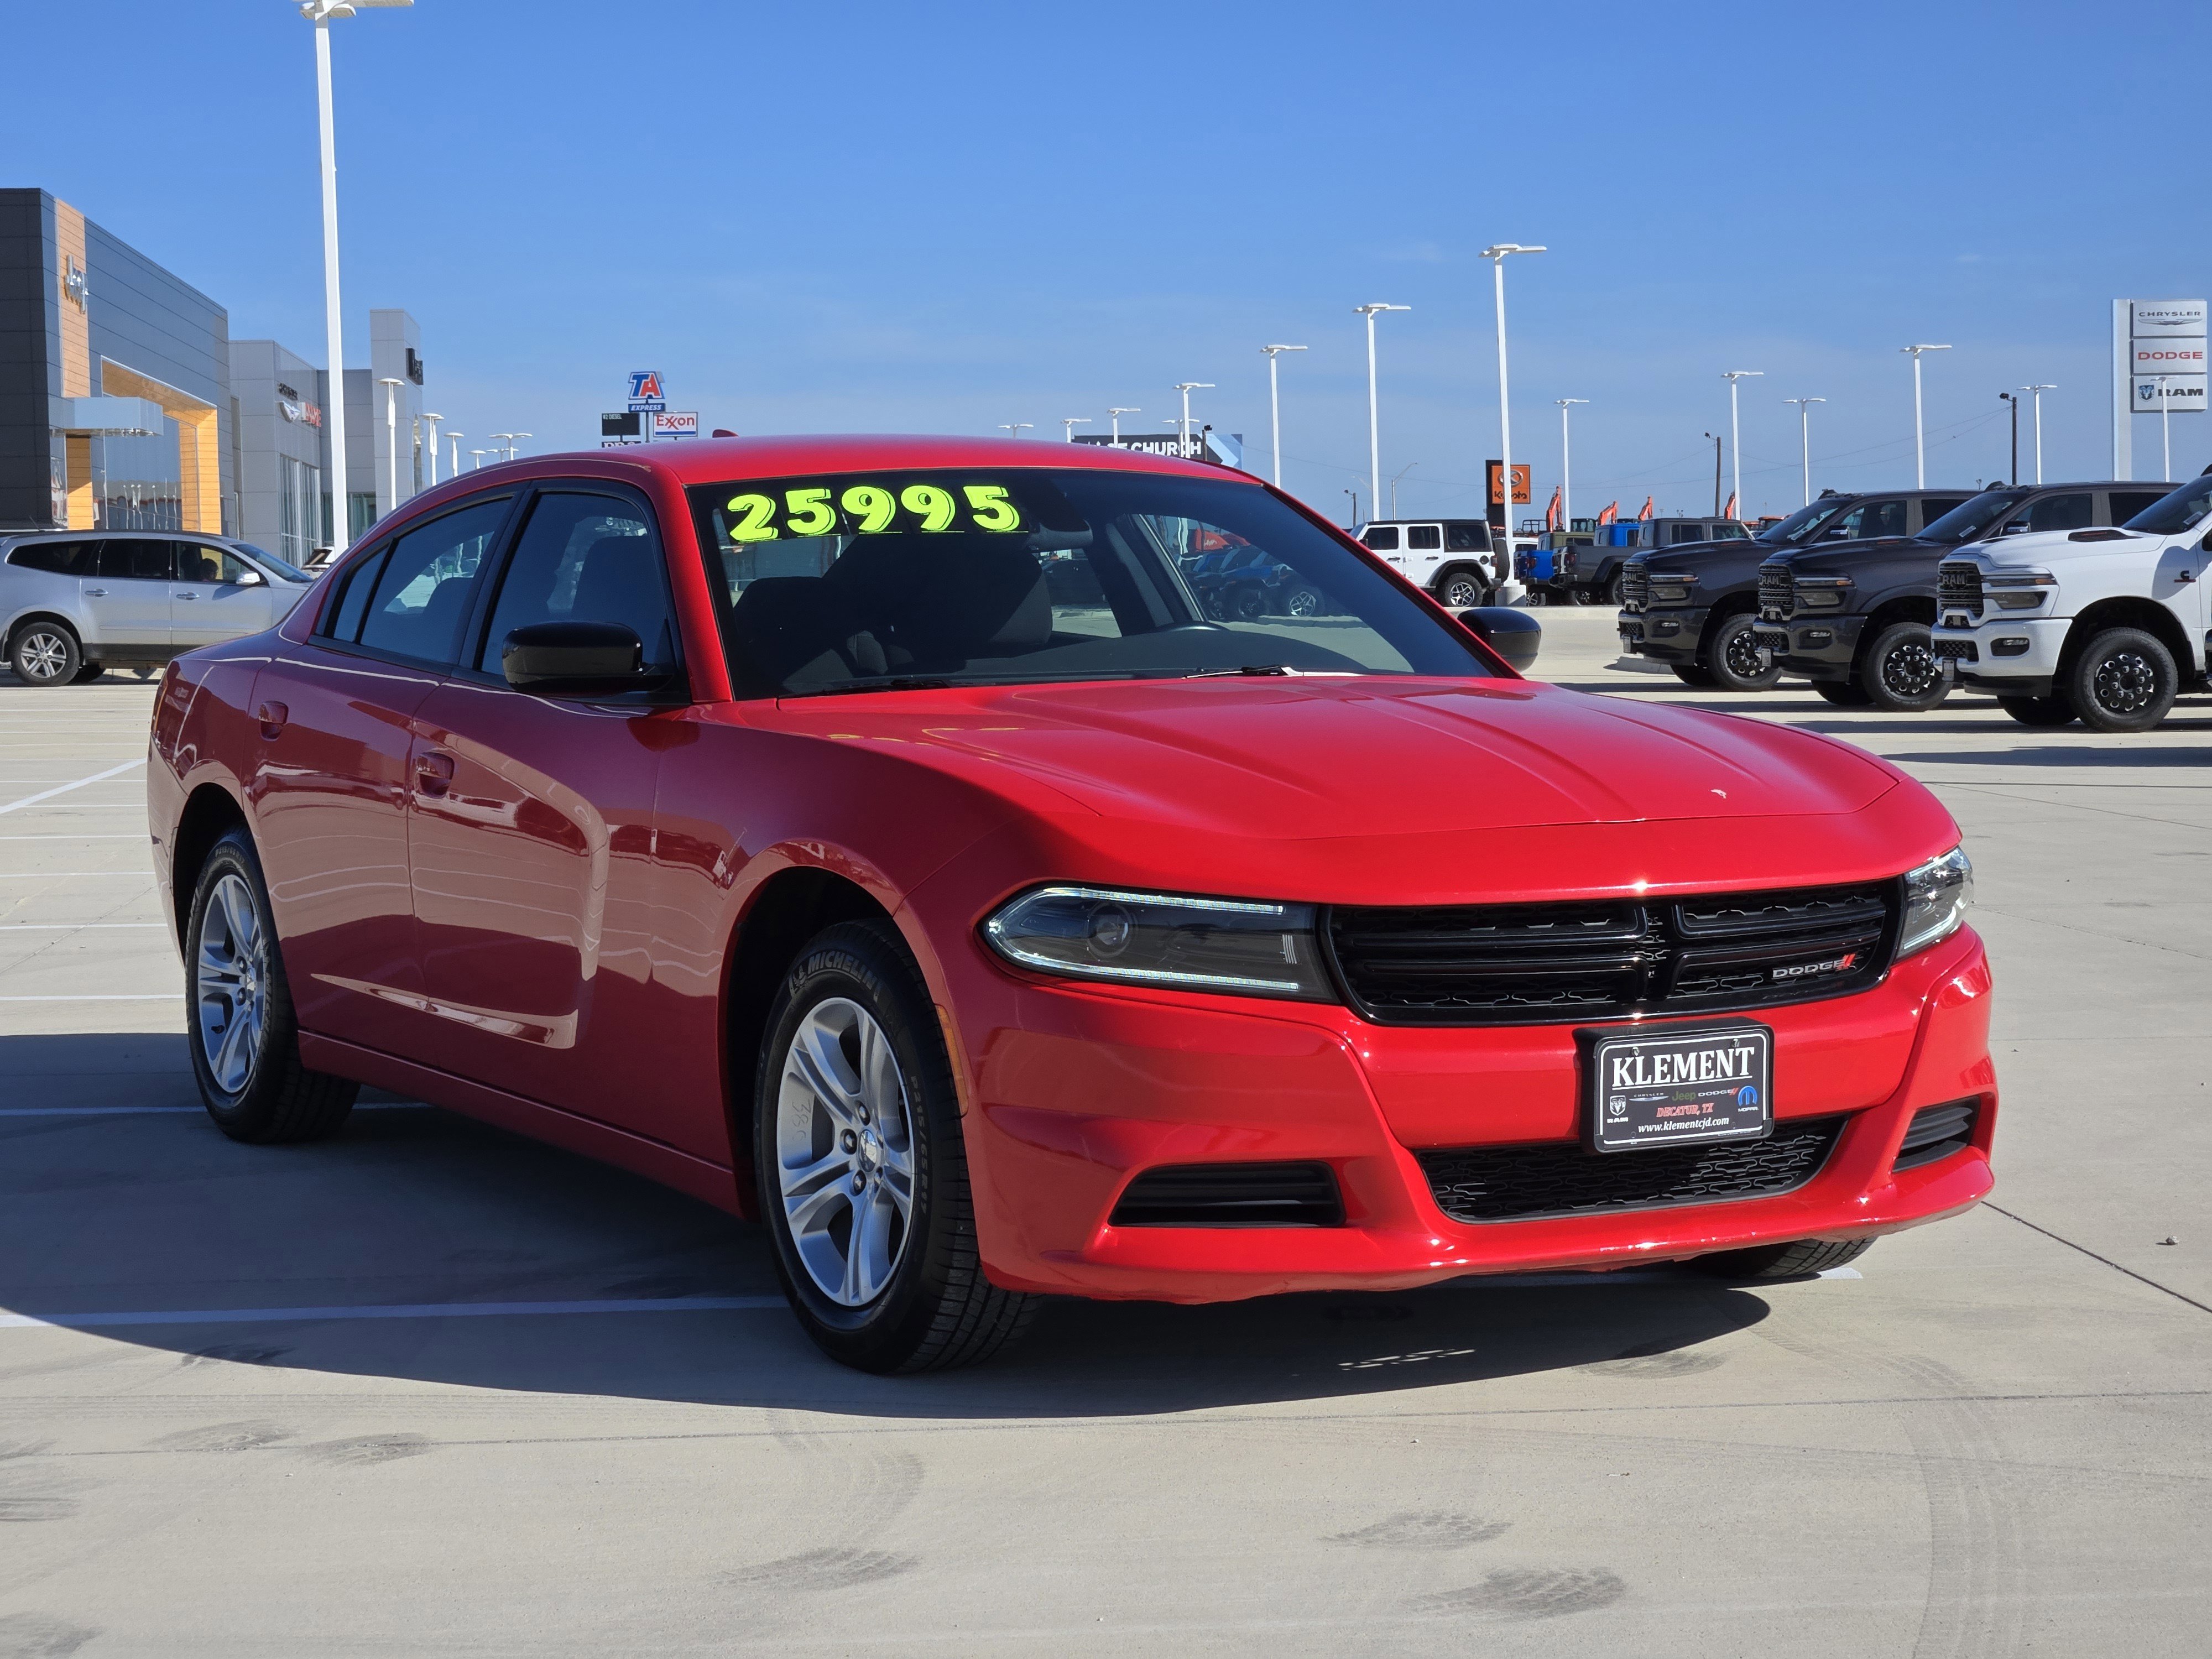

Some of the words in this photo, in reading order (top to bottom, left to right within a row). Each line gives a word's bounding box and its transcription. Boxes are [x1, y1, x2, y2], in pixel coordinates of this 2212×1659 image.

[2138, 351, 2203, 360] DODGE
[631, 373, 662, 398] TA
[2158, 388, 2204, 397] RAM
[656, 415, 695, 430] Exxon
[1494, 491, 1527, 499] Kota
[728, 485, 1021, 541] 25995
[1942, 573, 1966, 586] RAM
[807, 950, 878, 990] MICHELIN
[1772, 959, 1845, 978] DODGE
[1611, 1047, 1755, 1087] KLEMENT
[1672, 1091, 1696, 1101] Jeep
[1702, 1103, 1714, 1113] TX
[1637, 1117, 1730, 1133] www.klementcjd.com
